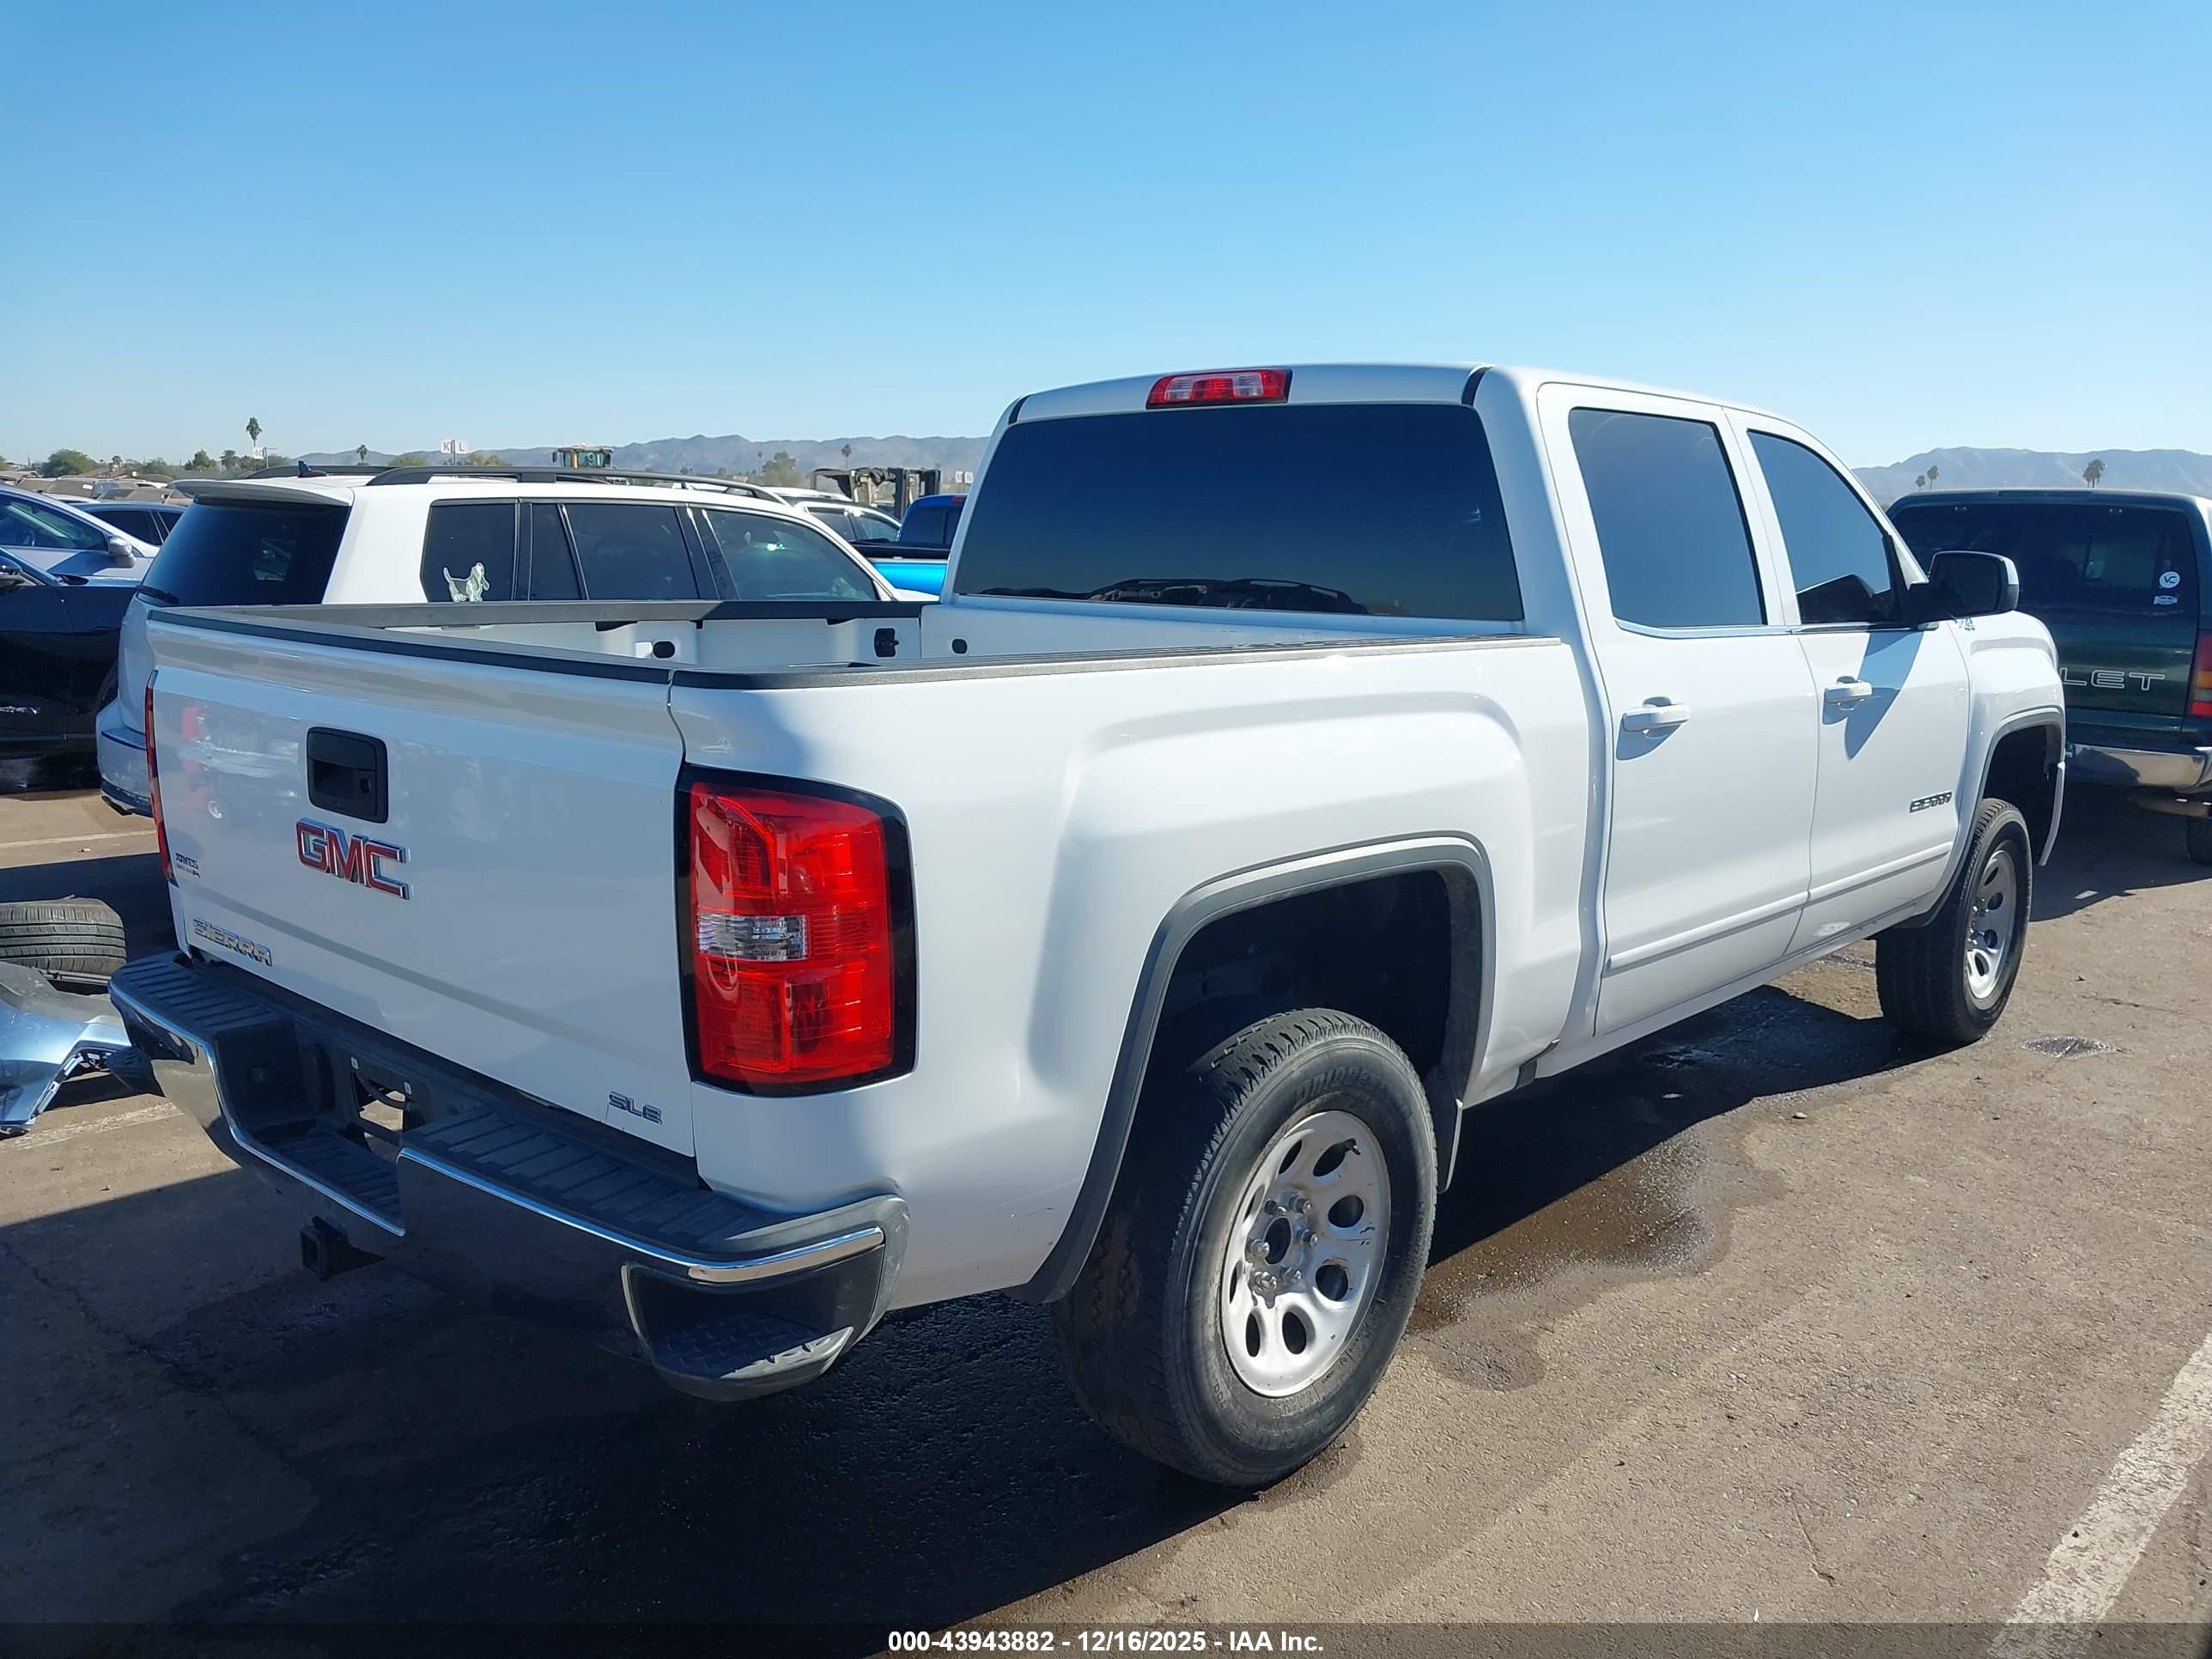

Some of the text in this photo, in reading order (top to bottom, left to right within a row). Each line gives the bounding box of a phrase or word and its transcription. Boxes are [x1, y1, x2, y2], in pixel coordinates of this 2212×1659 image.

[443, 441, 450, 452] K
[459, 441, 466, 452] L
[295, 817, 410, 900] GMC
[192, 916, 273, 967] SIERRA
[608, 1091, 663, 1125] SLE
